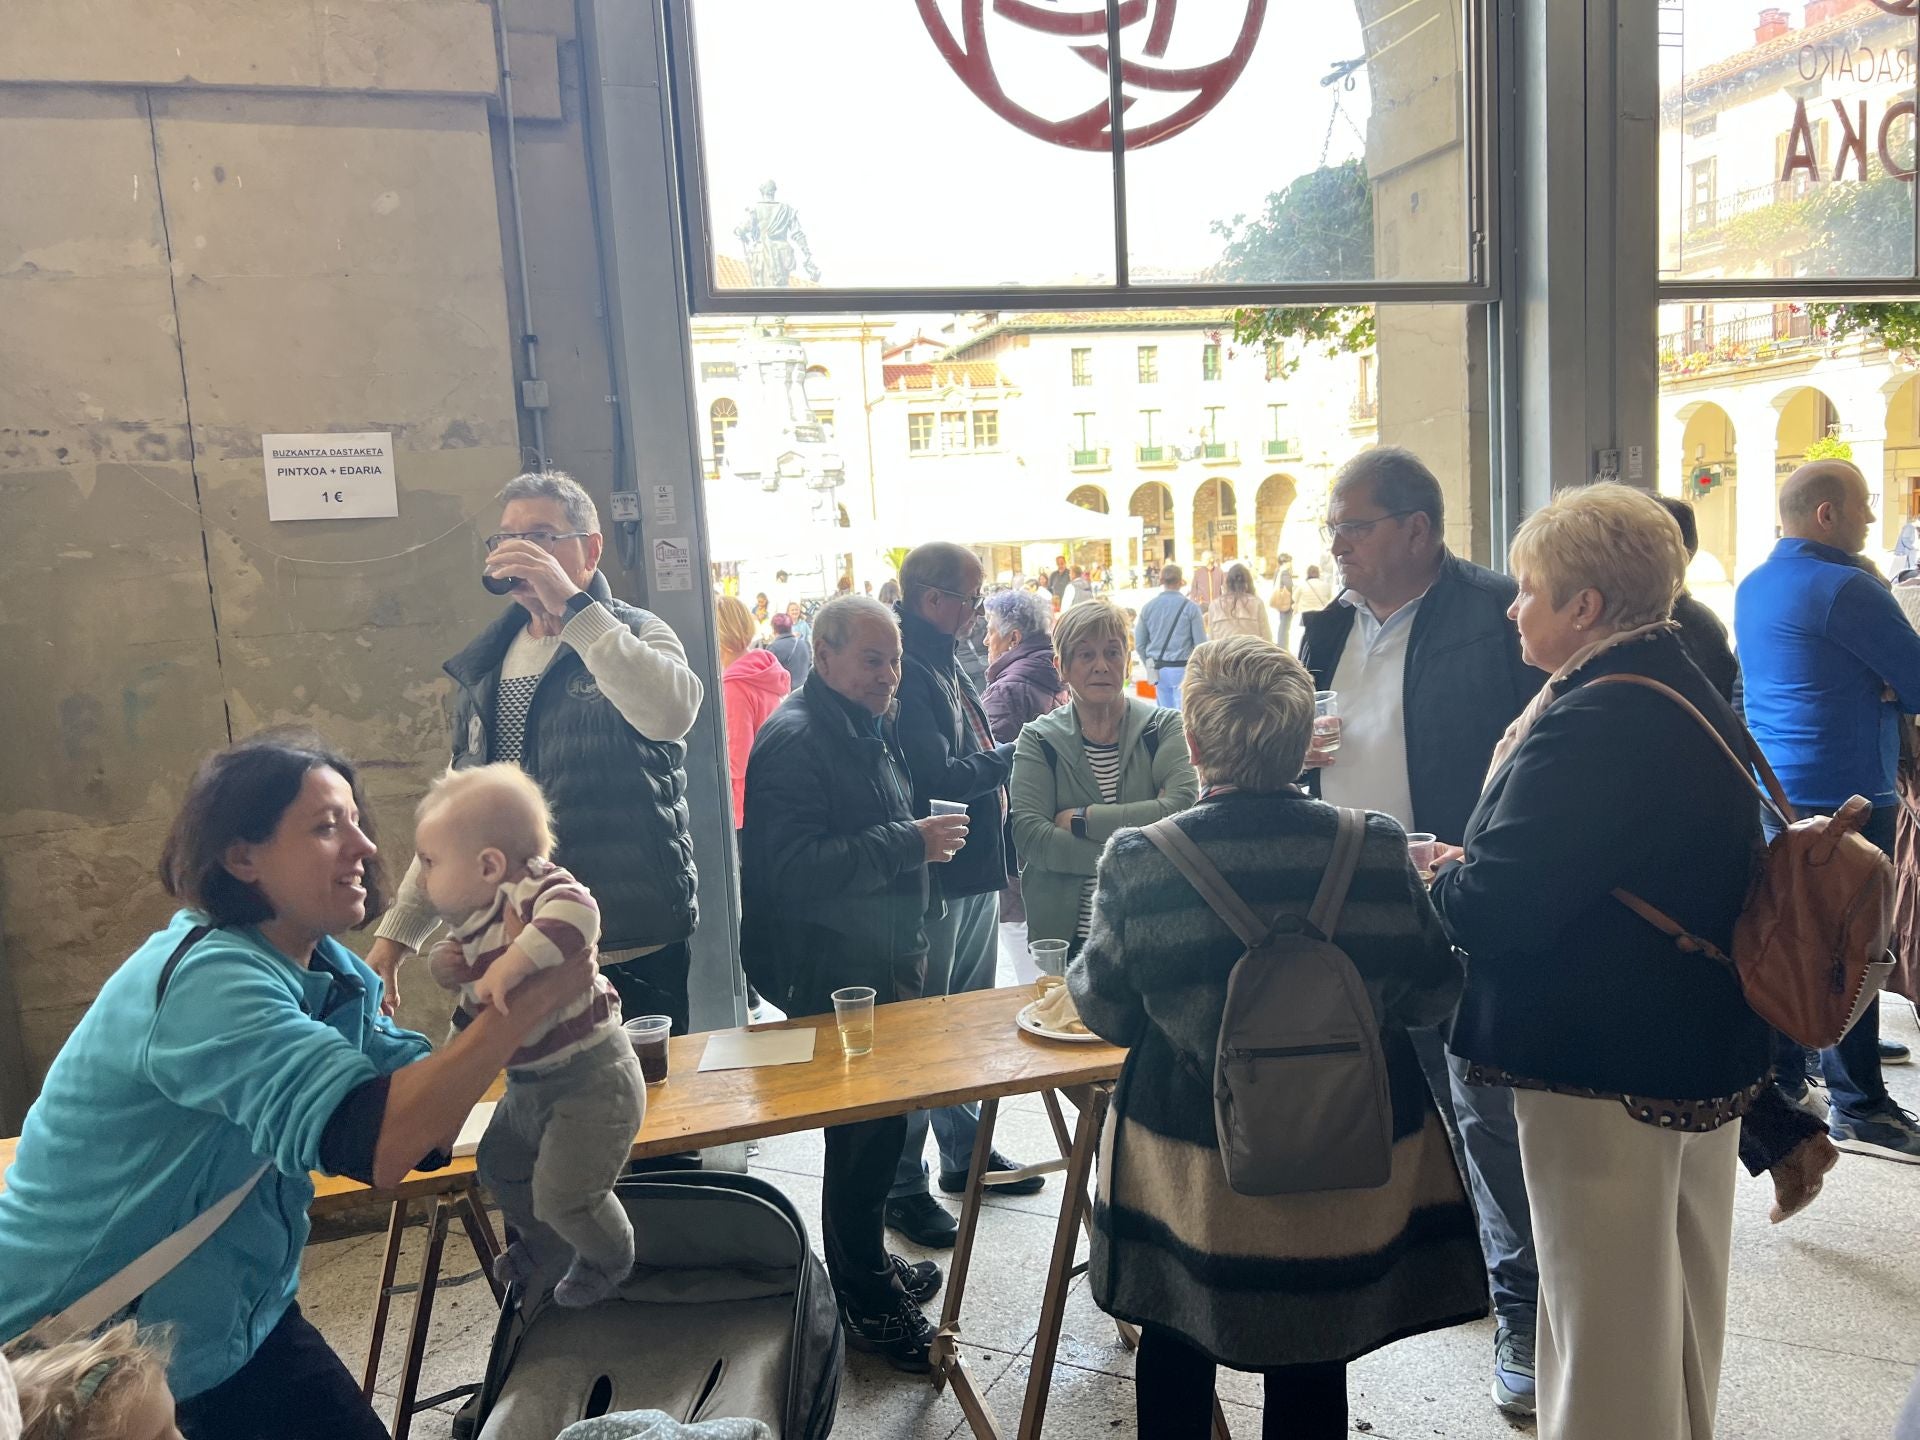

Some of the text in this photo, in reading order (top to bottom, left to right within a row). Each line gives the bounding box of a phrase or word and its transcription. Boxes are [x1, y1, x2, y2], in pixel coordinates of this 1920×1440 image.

[272, 448, 383, 457] BUZKANTZA DASTAKETA
[277, 467, 327, 476] PINTXOA
[340, 466, 382, 475] EDARIA
[322, 491, 343, 503] 1 €
